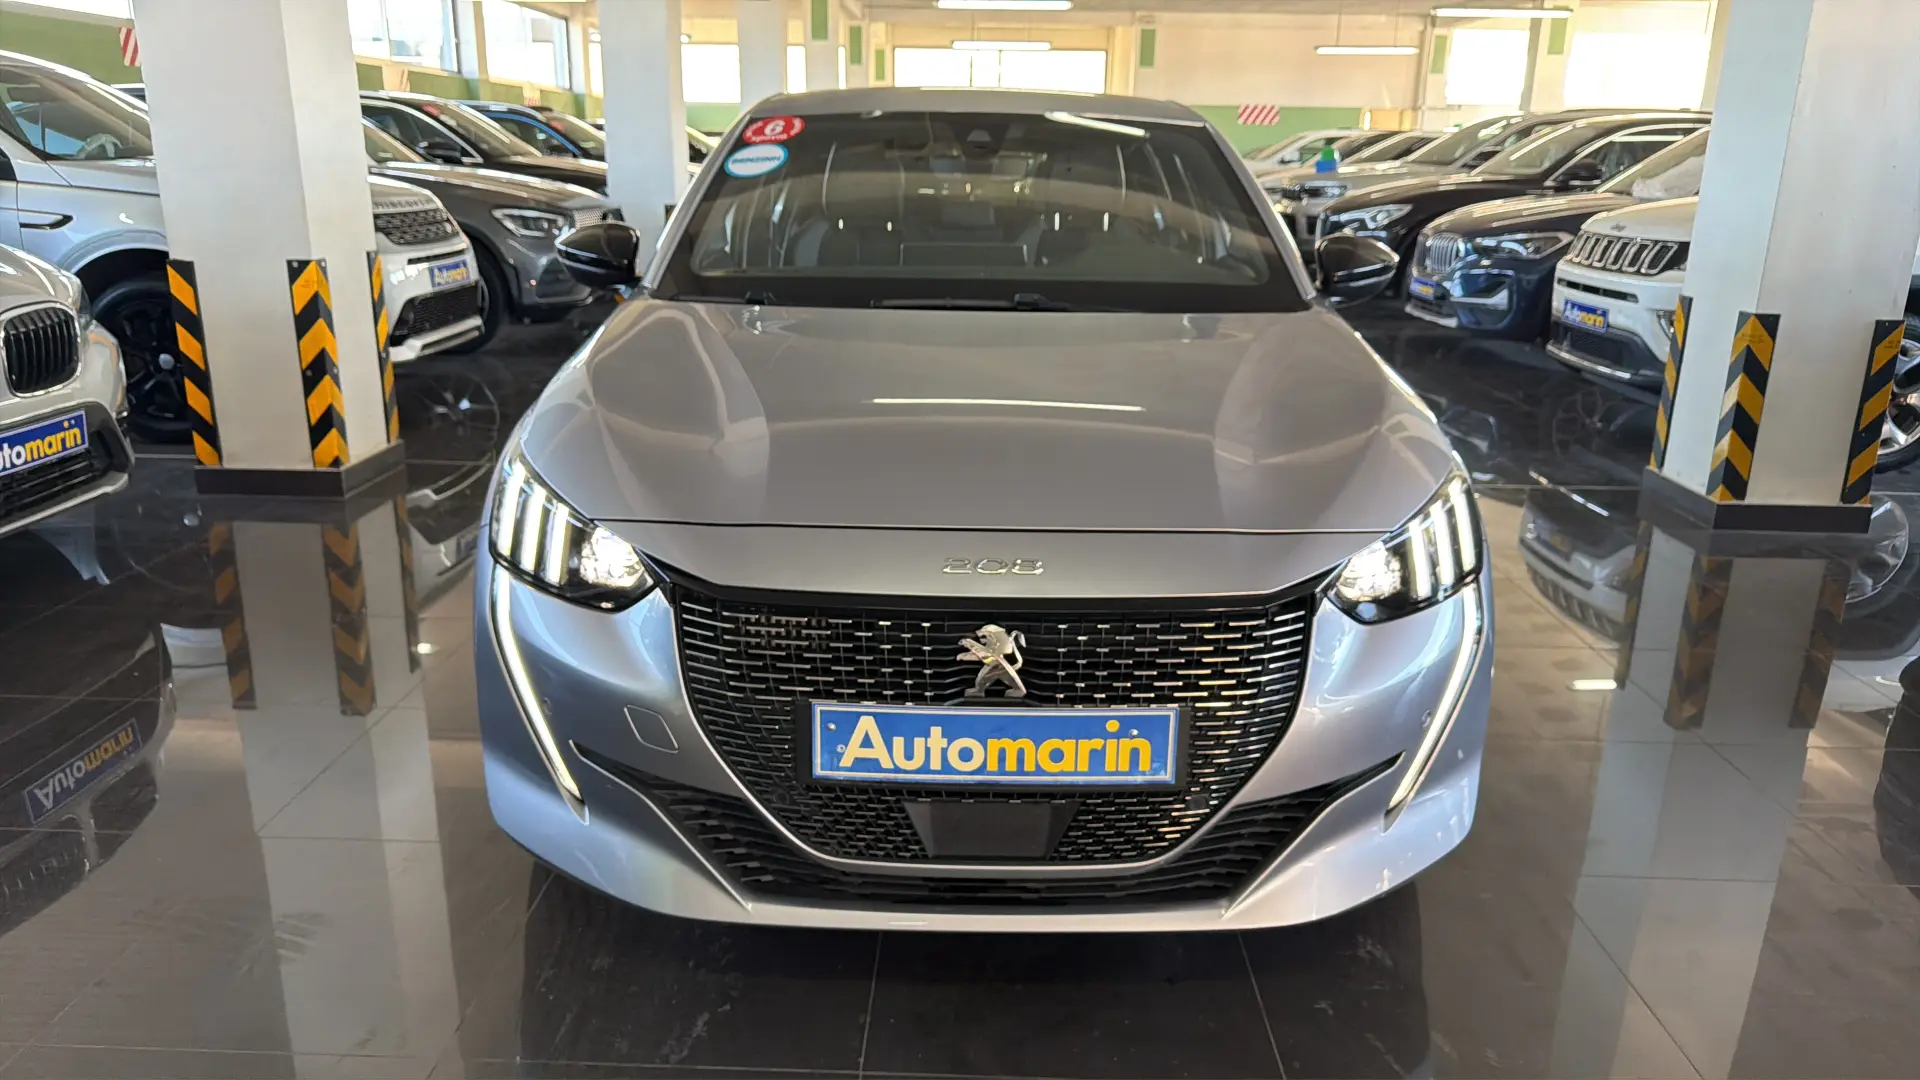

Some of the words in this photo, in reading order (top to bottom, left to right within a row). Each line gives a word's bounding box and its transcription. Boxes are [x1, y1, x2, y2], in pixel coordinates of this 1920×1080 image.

[763, 119, 786, 136] 6
[942, 557, 1044, 576] 208
[839, 715, 1152, 773] Automarin
